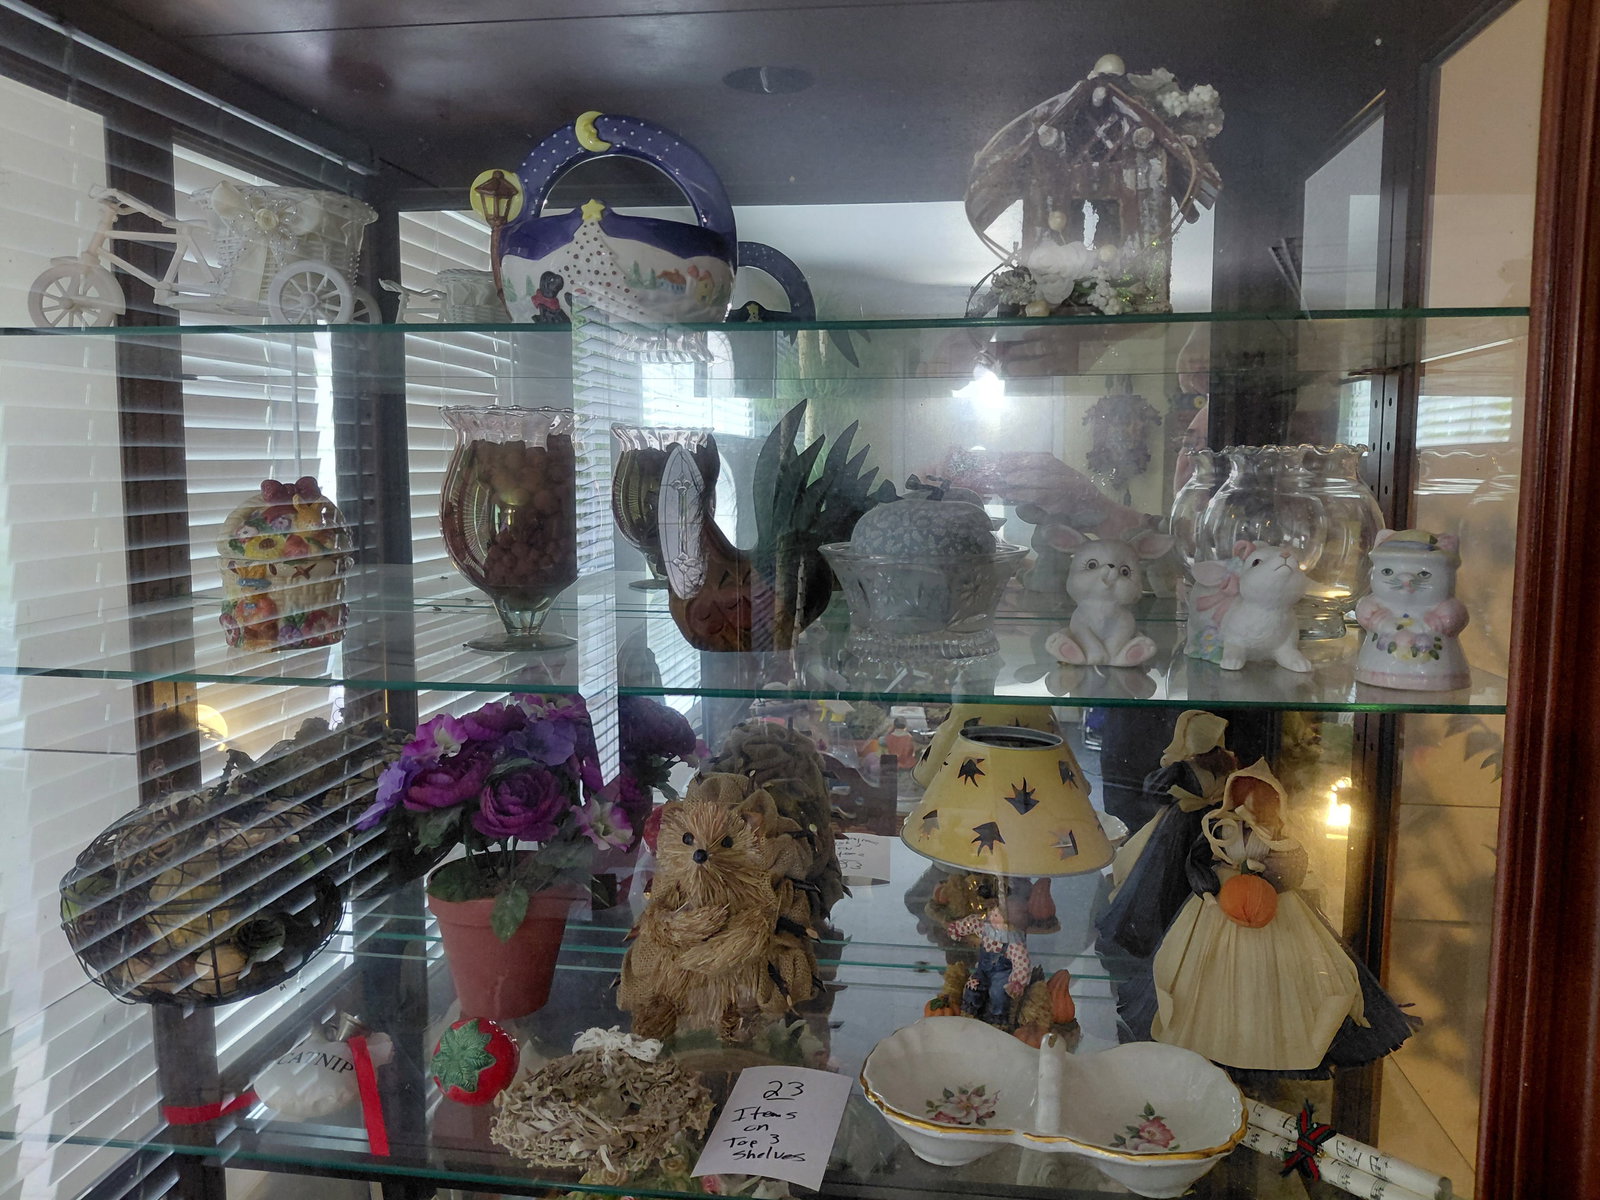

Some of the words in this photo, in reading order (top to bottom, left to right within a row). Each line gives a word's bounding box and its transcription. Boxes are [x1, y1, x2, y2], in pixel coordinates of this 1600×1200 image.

[277, 1051, 354, 1074] CATNIP
[763, 1080, 804, 1099] 23
[732, 1106, 798, 1122] Items
[744, 1123, 769, 1132] on
[723, 1137, 758, 1148] Top
[770, 1133, 780, 1145] 3
